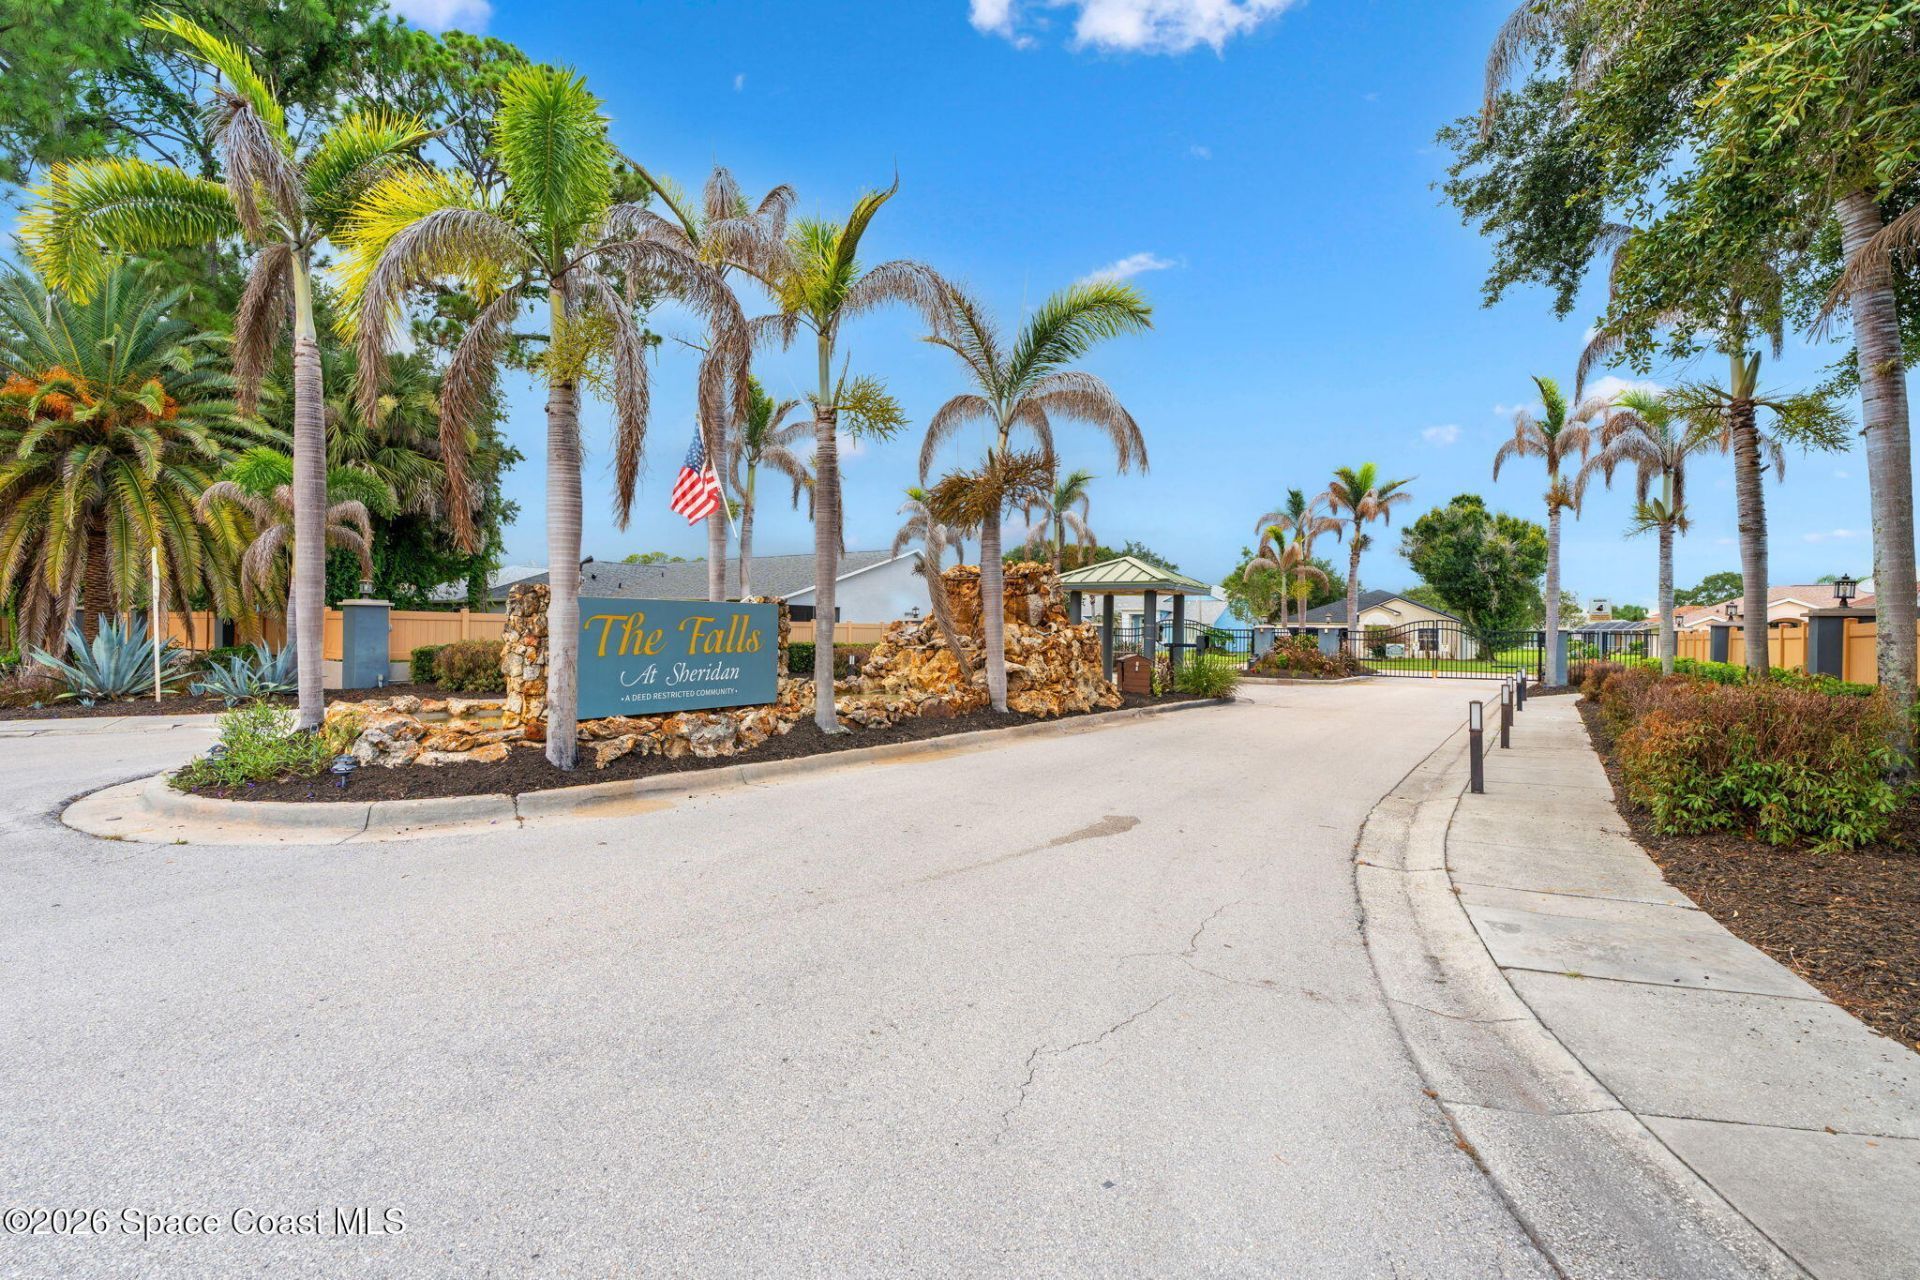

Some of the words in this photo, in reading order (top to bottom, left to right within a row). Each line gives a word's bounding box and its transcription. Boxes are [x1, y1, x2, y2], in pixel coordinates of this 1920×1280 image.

[583, 612, 668, 656] The
[678, 614, 766, 656] Falls
[620, 663, 658, 687] At
[665, 661, 740, 686] Sheridan
[632, 693, 652, 701] DEED
[654, 689, 695, 700] RESTRICTED
[696, 687, 735, 697] COMMUNITY
